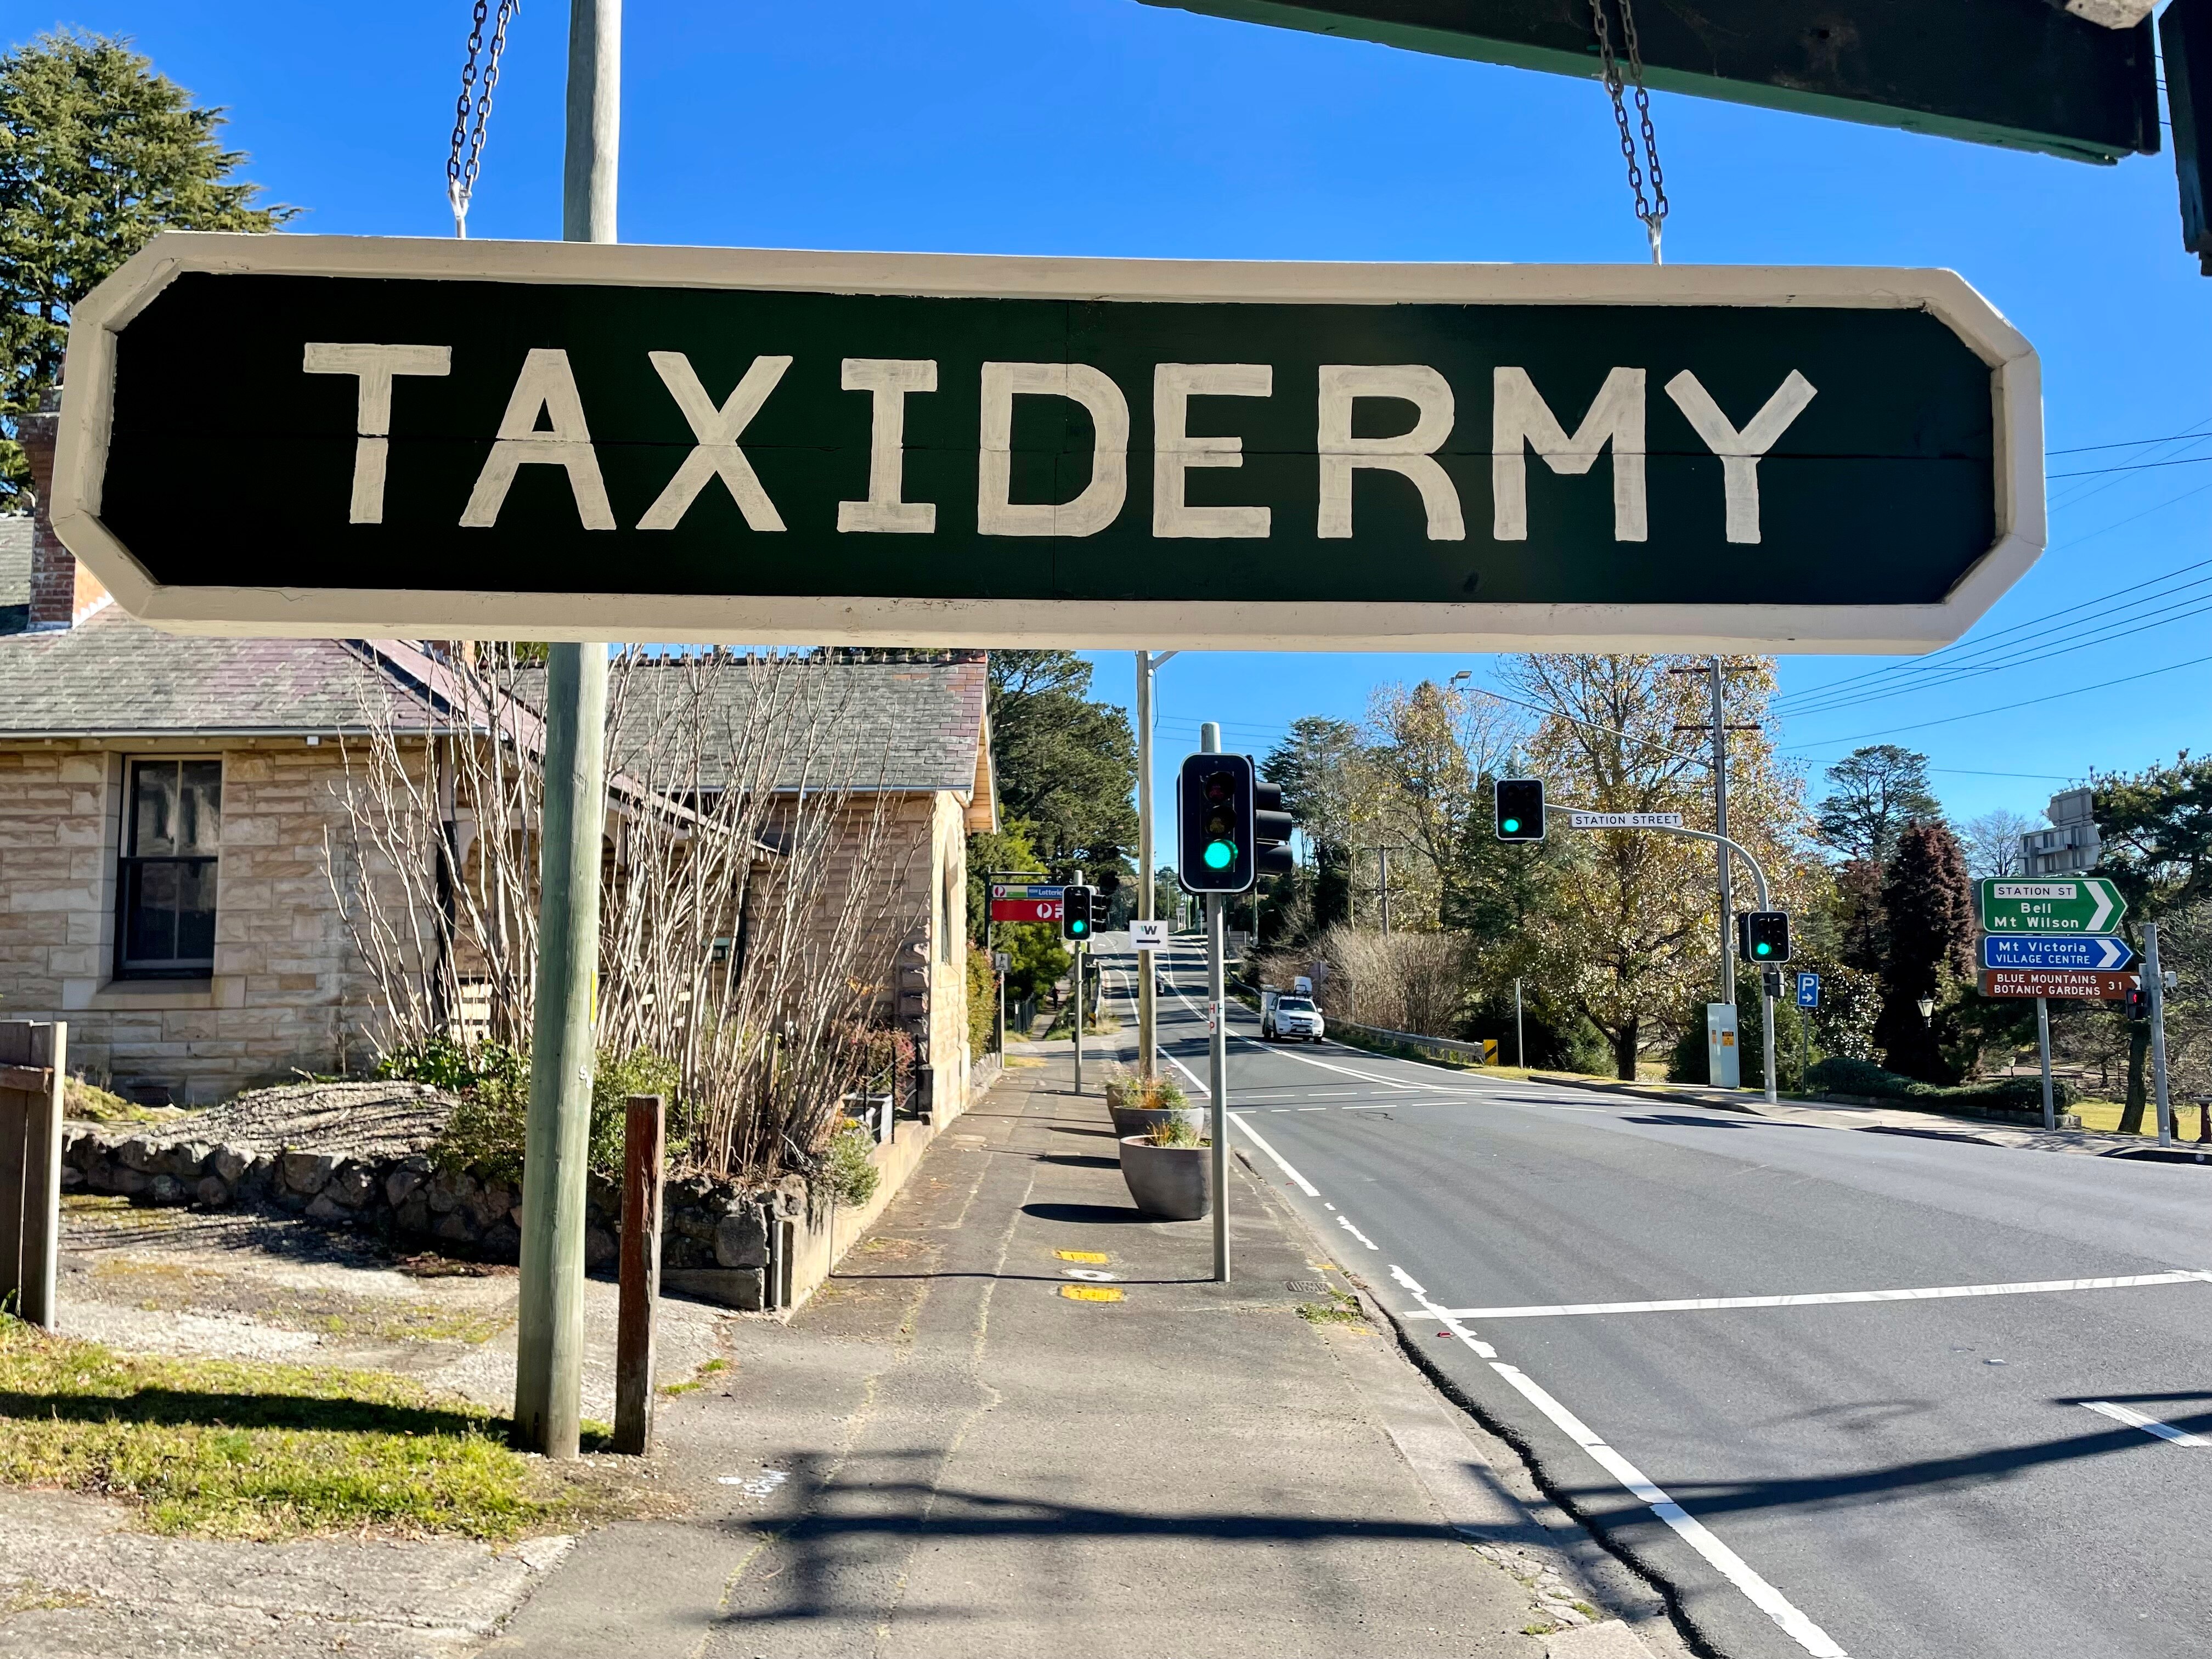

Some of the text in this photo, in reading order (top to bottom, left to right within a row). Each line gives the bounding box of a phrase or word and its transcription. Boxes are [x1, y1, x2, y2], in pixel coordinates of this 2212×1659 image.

[303, 342, 1818, 544] TAXIDERMY
[1576, 815, 1679, 825] STATION STREET
[1998, 887, 2050, 895] STATION
[2021, 902, 2051, 913] Bell
[1994, 916, 2079, 928] Mt Wilson
[1999, 941, 2086, 952] Mt Victoria
[1996, 954, 2090, 964] VILLAGE CENTRE
[1802, 977, 1815, 991] P
[1997, 974, 2097, 984] BLUE MOUNTAINS
[1994, 985, 2101, 995] BOTANIC GARDENS
[2108, 981, 2122, 990] 31
[1210, 1003, 1215, 1014] H
[1217, 1003, 1223, 1014] H
[1210, 1022, 1215, 1031] P
